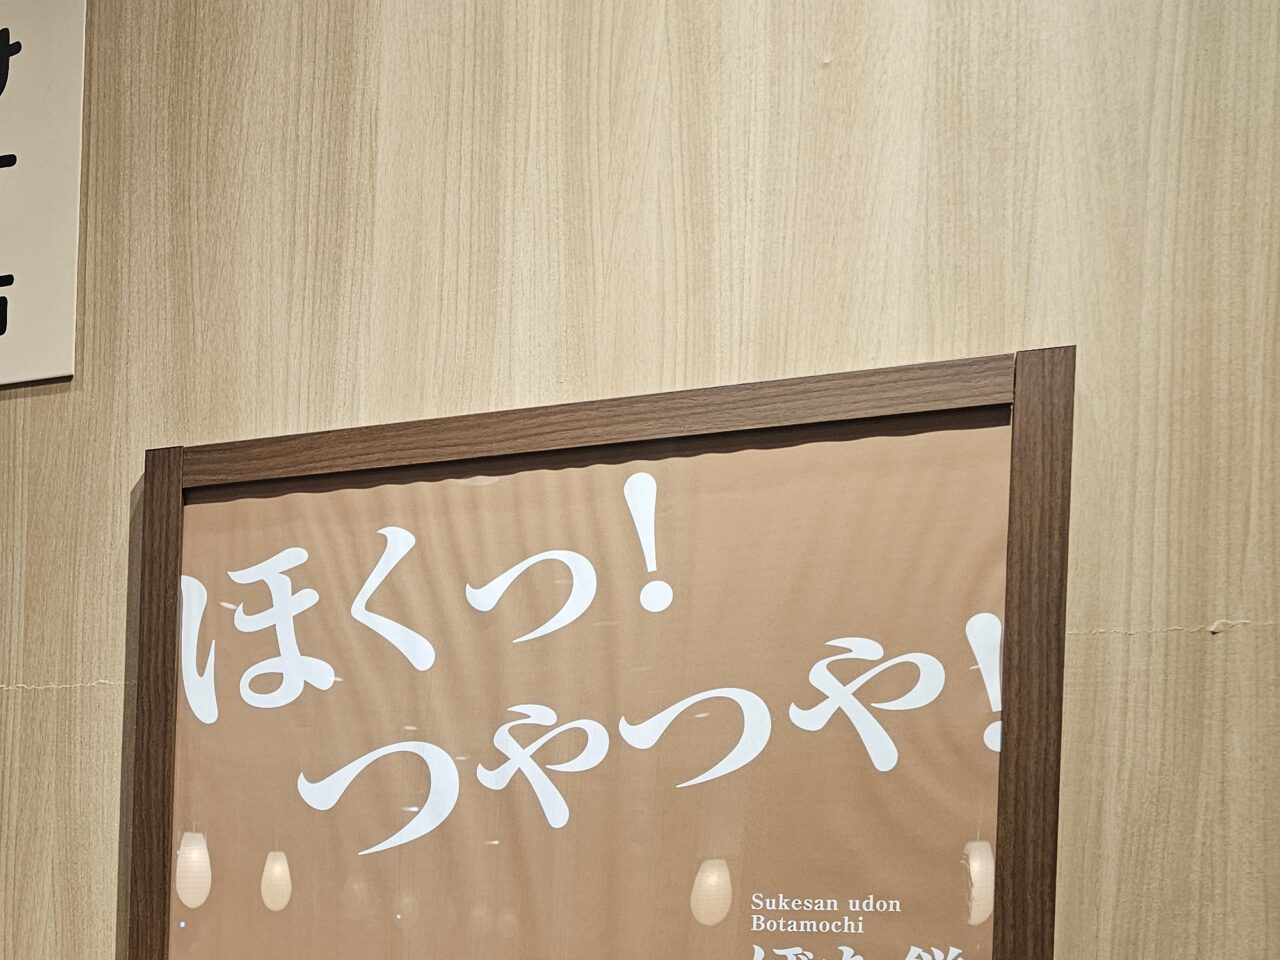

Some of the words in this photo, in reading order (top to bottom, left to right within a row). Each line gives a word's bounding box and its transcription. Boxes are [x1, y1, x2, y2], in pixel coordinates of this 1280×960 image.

[181, 472, 674, 724] ほくっ!
[297, 613, 1002, 856] つやつや!
[751, 892, 839, 912] Sukesan
[848, 894, 902, 912] udon
[751, 915, 864, 934] Botamochi
